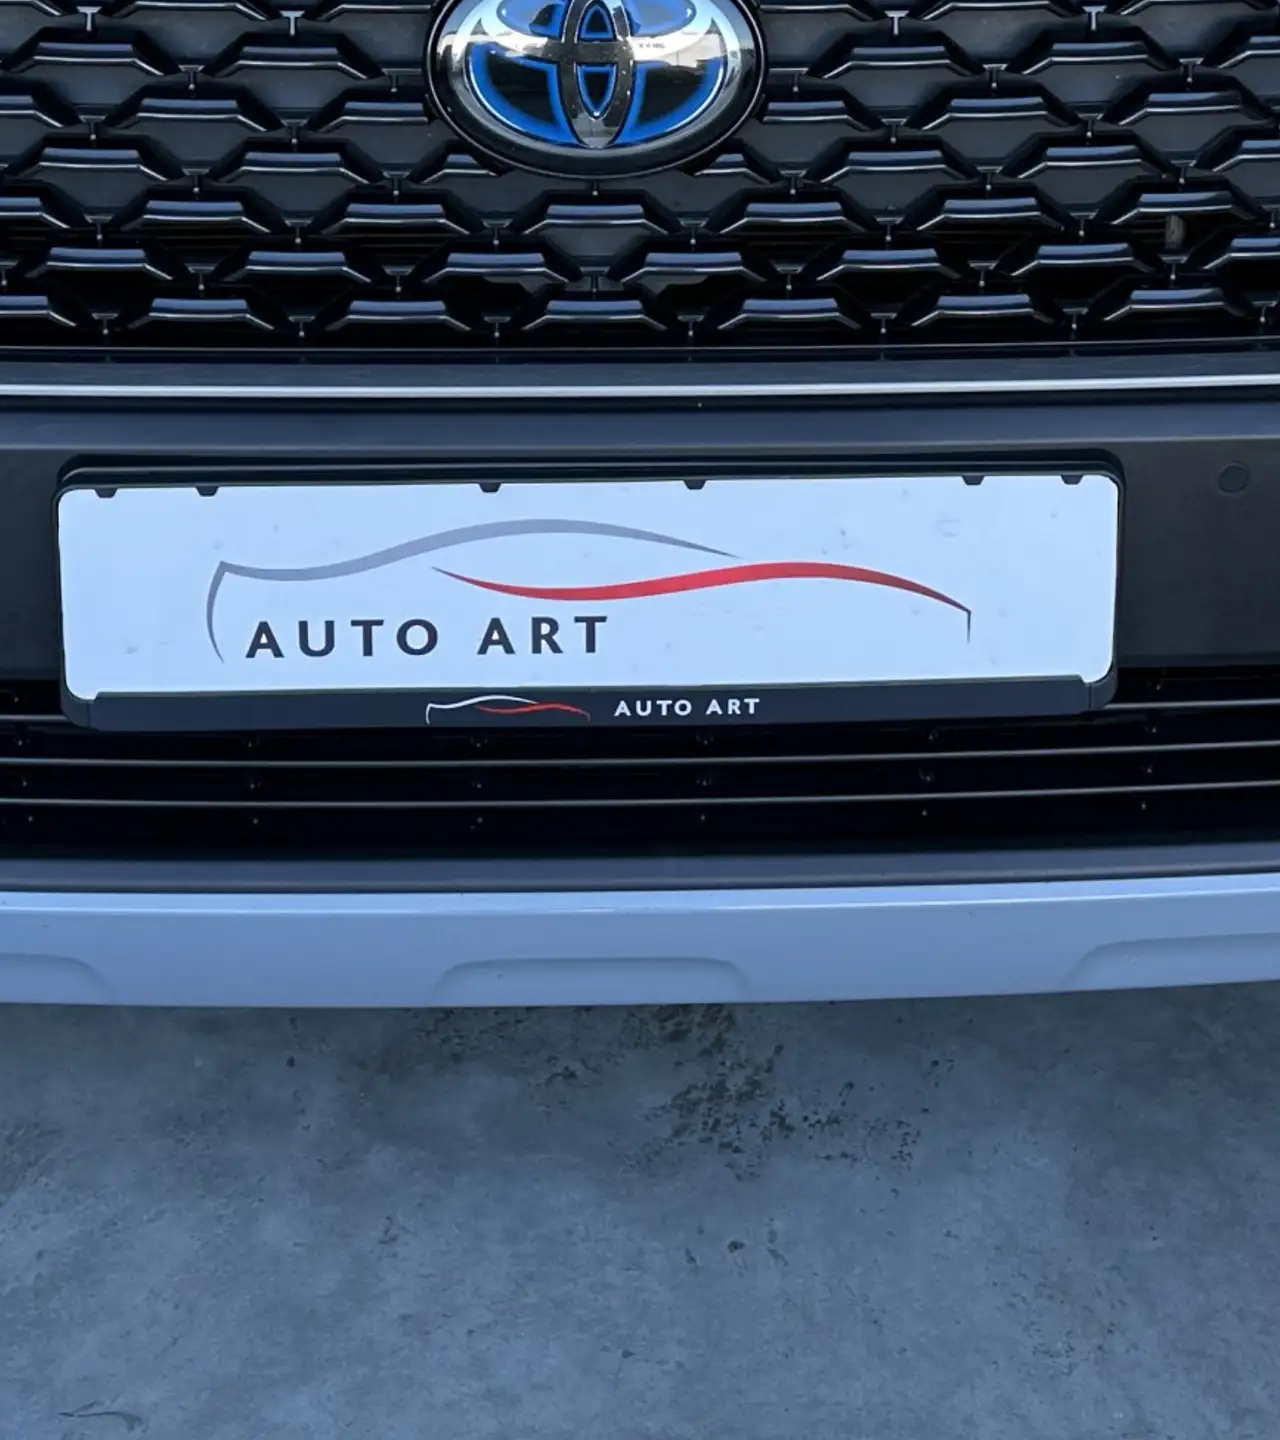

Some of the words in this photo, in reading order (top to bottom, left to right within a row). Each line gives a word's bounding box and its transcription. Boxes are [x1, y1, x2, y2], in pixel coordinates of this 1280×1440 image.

[245, 617, 439, 659] AUTO
[476, 615, 608, 655] ART
[613, 699, 693, 718] AUTO
[705, 697, 761, 717] ART
